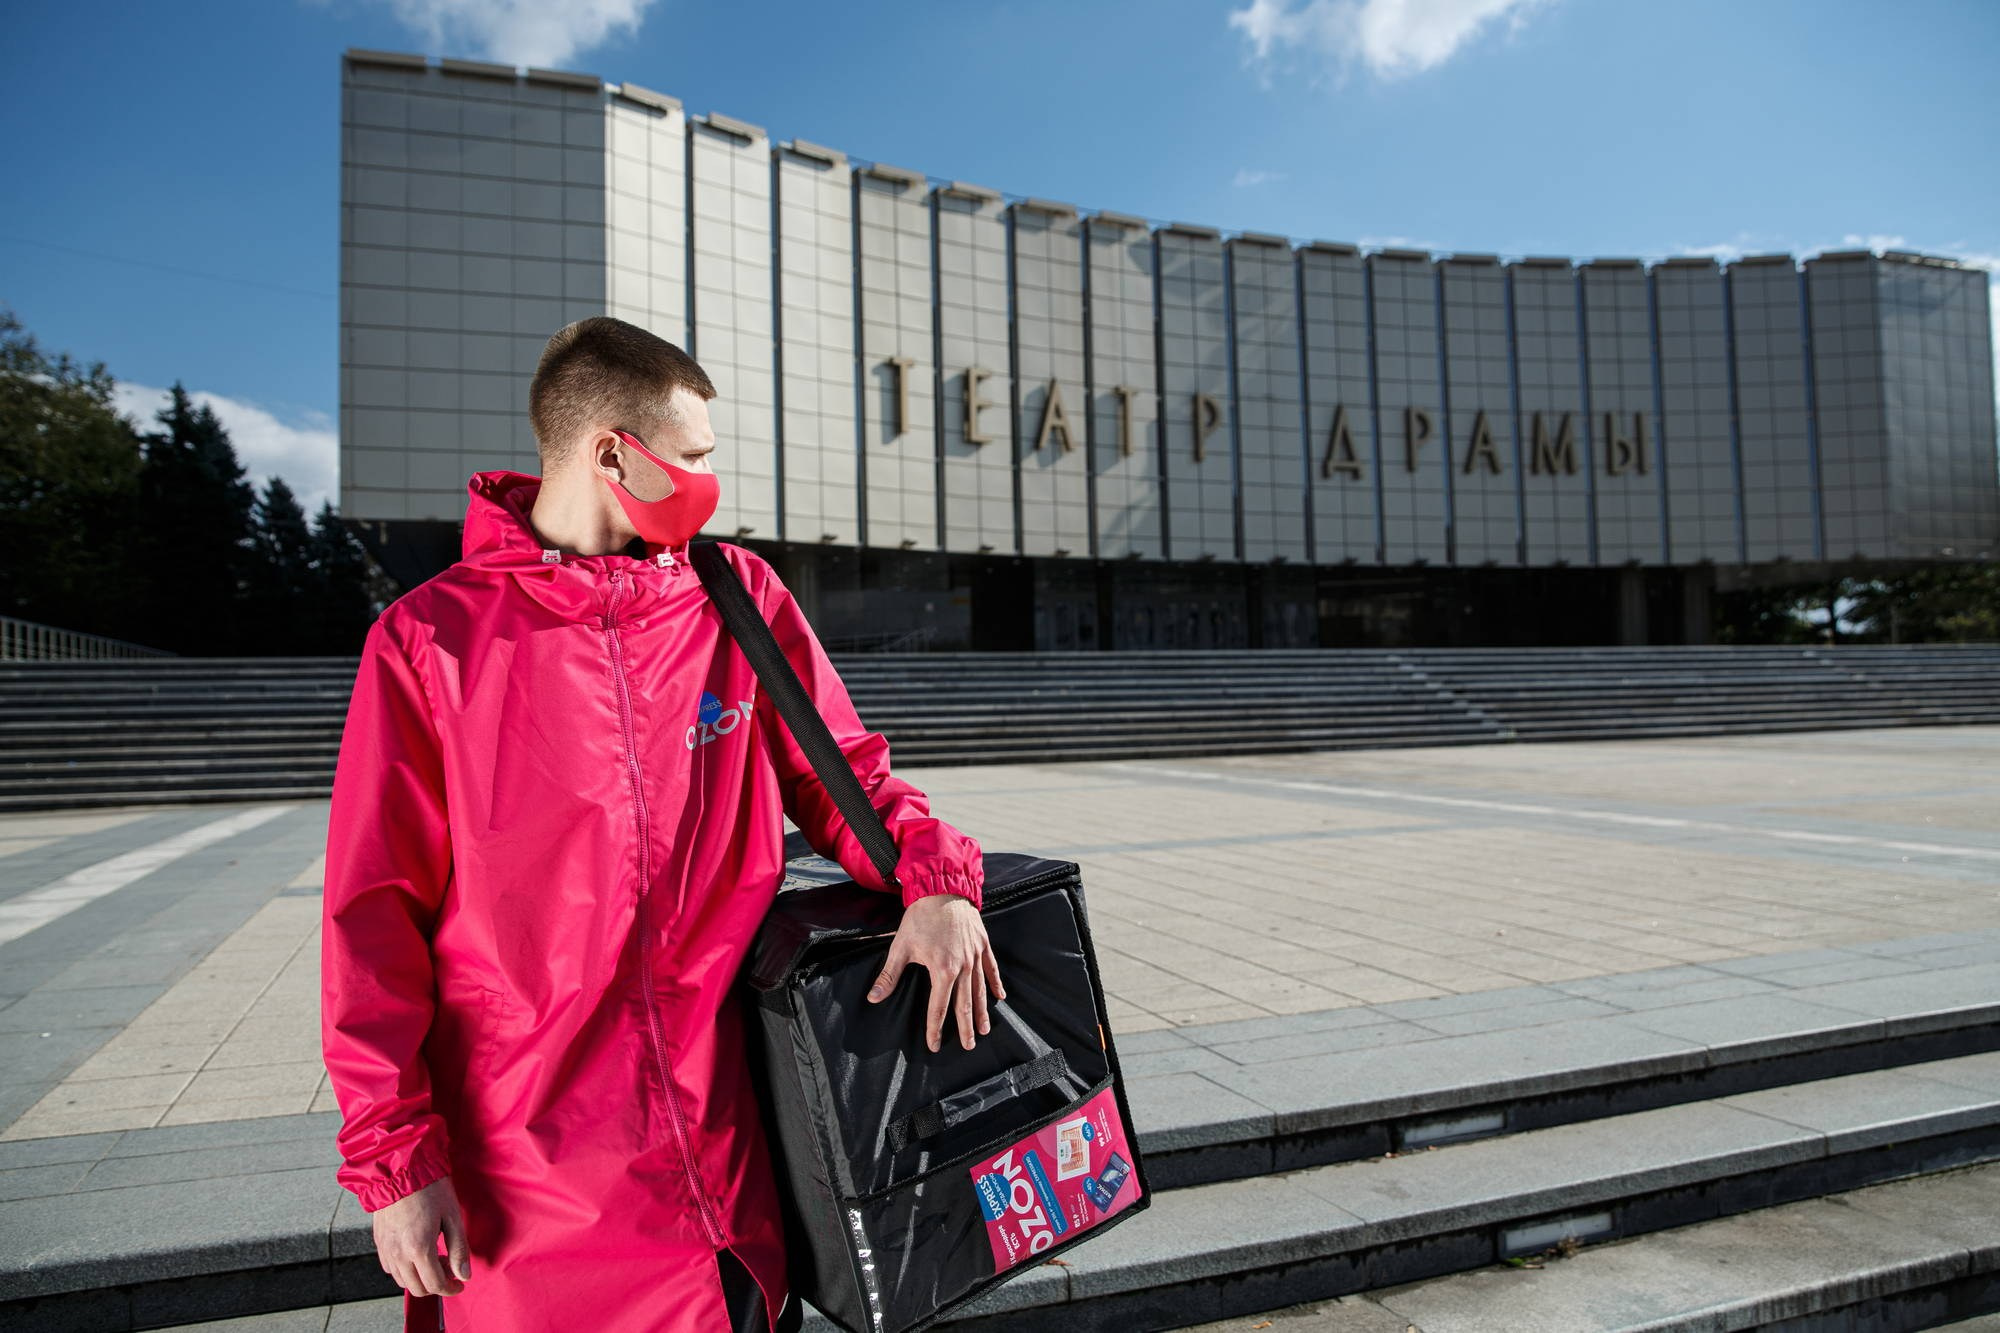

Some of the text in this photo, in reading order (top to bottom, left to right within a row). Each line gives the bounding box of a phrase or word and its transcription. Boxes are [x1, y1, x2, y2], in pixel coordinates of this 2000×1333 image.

[886, 356, 1650, 480] ТЕАТР ДРАМЫ
[976, 1174, 1005, 1220] EXPRESS
[992, 1149, 1053, 1254] OZON
[1010, 1232, 1020, 1250] ЕСТЬ
